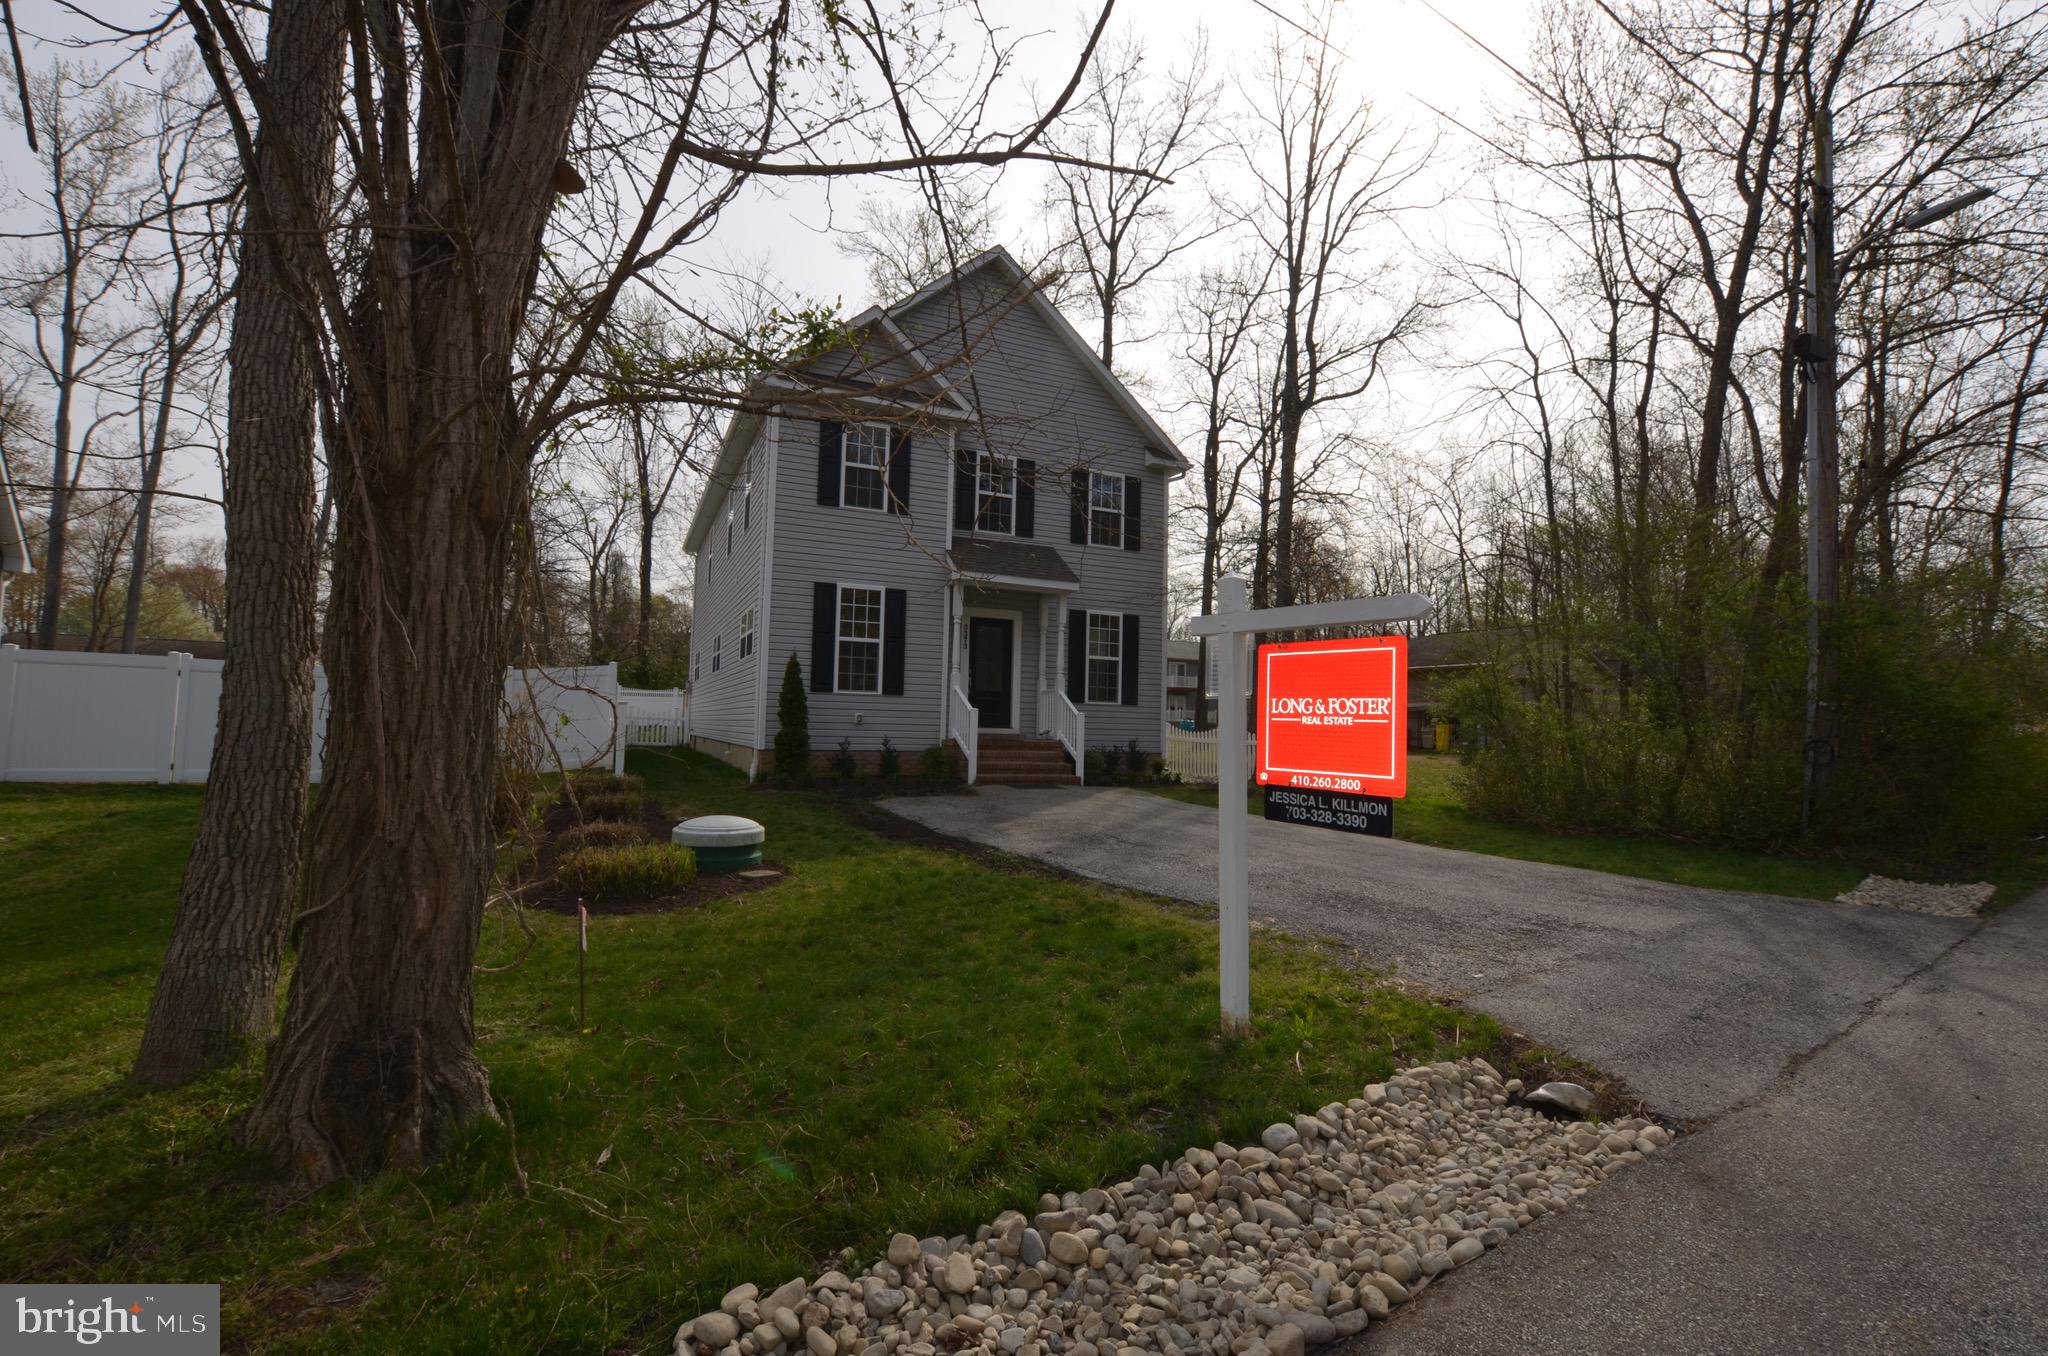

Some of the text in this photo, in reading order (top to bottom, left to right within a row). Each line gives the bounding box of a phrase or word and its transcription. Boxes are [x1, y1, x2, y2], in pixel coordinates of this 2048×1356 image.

[1271, 698, 1313, 714] LONG
[1315, 699, 1326, 714] &
[1302, 716, 1353, 725] REAL ESTATE
[1291, 775, 1361, 791] 410.260.2800
[1269, 791, 1388, 817] JESSICA L. KILLMON
[1286, 806, 1368, 829] 703-328-3390
